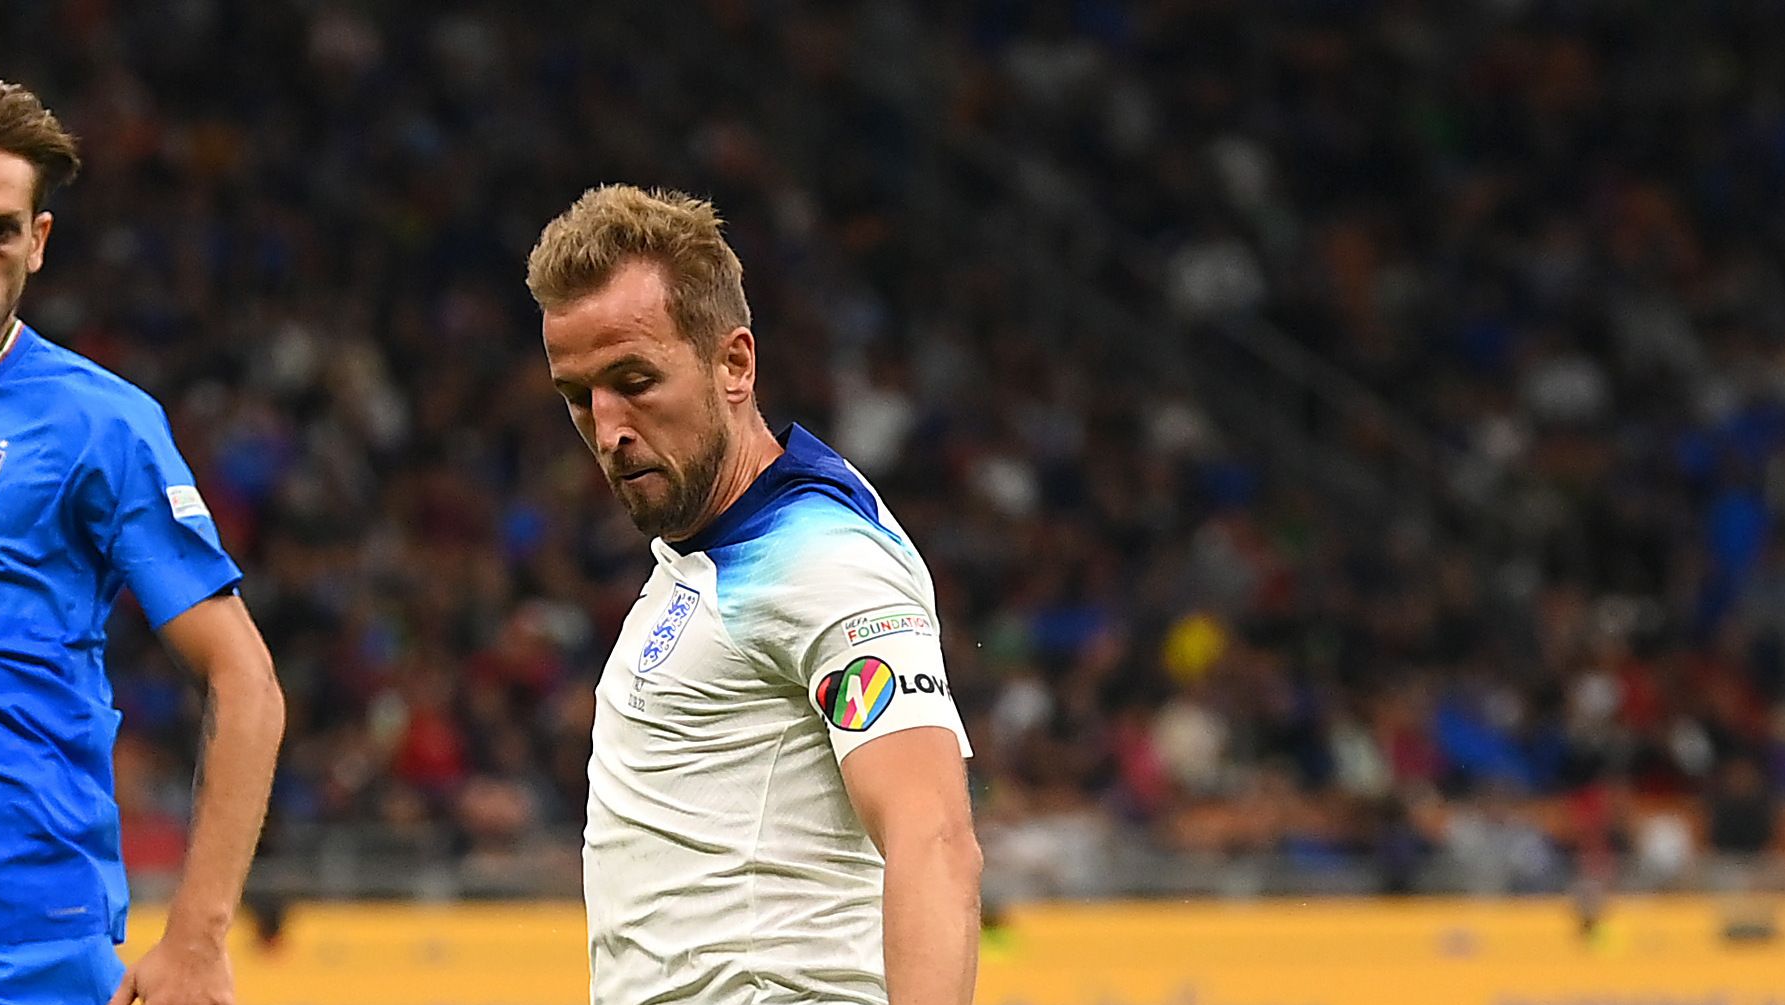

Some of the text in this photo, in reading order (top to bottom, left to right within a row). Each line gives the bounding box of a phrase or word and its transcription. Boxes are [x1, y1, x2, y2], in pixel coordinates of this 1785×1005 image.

[846, 617, 868, 630] UEFA
[848, 616, 930, 642] FOUNDATION
[845, 674, 868, 723] 1
